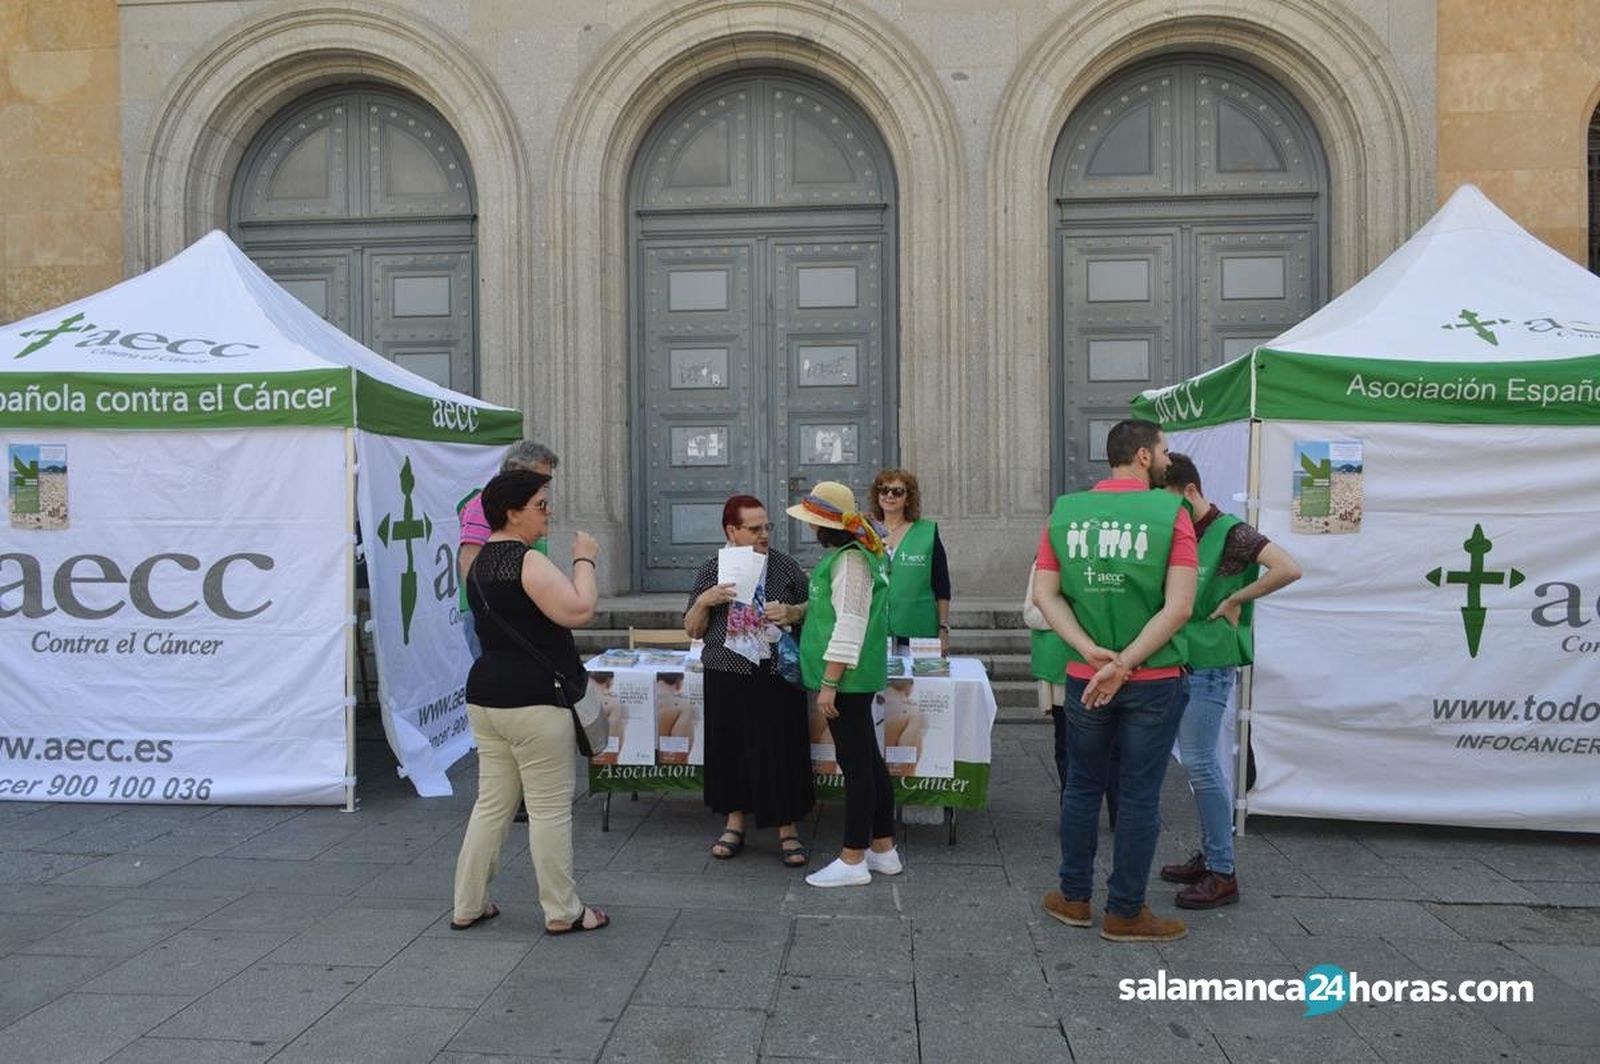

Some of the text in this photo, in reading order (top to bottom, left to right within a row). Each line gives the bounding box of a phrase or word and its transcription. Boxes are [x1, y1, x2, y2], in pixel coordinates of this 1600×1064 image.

[75, 329, 260, 358] aecc
[96, 387, 188, 413] contra
[199, 383, 223, 412] el
[233, 380, 337, 412] Cáncer
[1346, 373, 1496, 401] Asociación
[432, 399, 480, 433] aecc
[31, 631, 223, 656] Contra el Cáncer
[46, 774, 98, 797] 900
[108, 776, 156, 799] 100
[162, 777, 214, 800] 036
